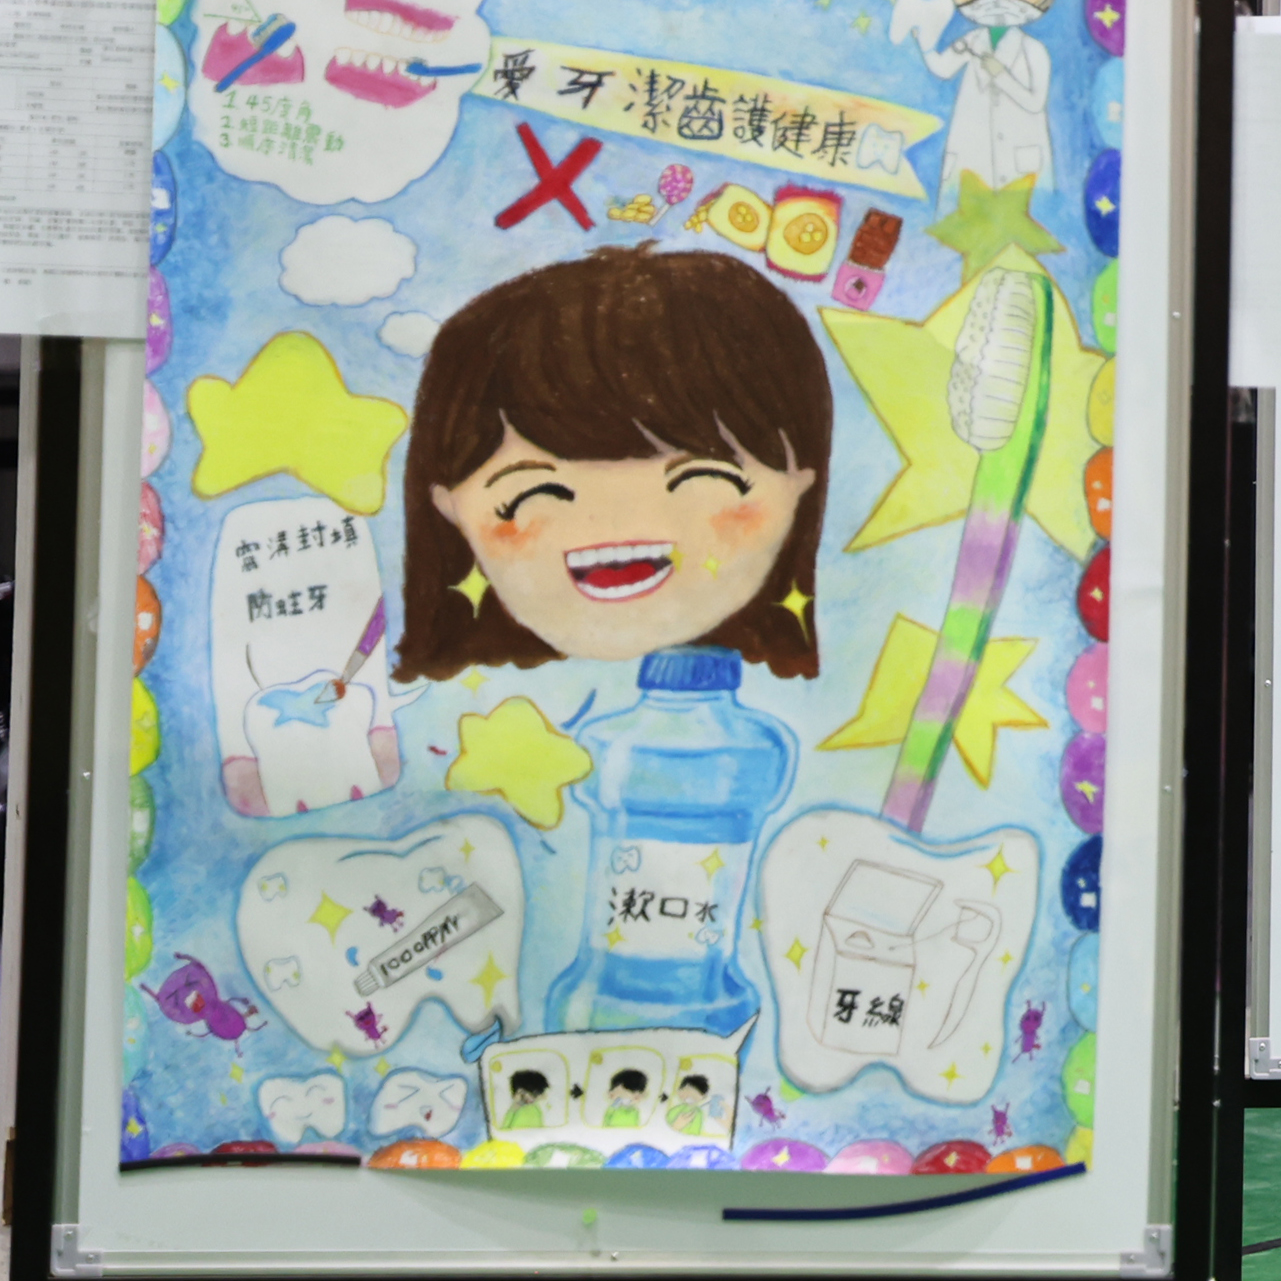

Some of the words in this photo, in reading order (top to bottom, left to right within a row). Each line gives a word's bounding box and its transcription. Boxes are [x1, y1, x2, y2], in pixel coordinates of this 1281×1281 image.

[492, 48, 859, 168] 愛牙潔齒護健康
[246, 583, 328, 623] 防蛀牙
[607, 887, 719, 926] 漱口水
[832, 989, 906, 1028] 牙線
